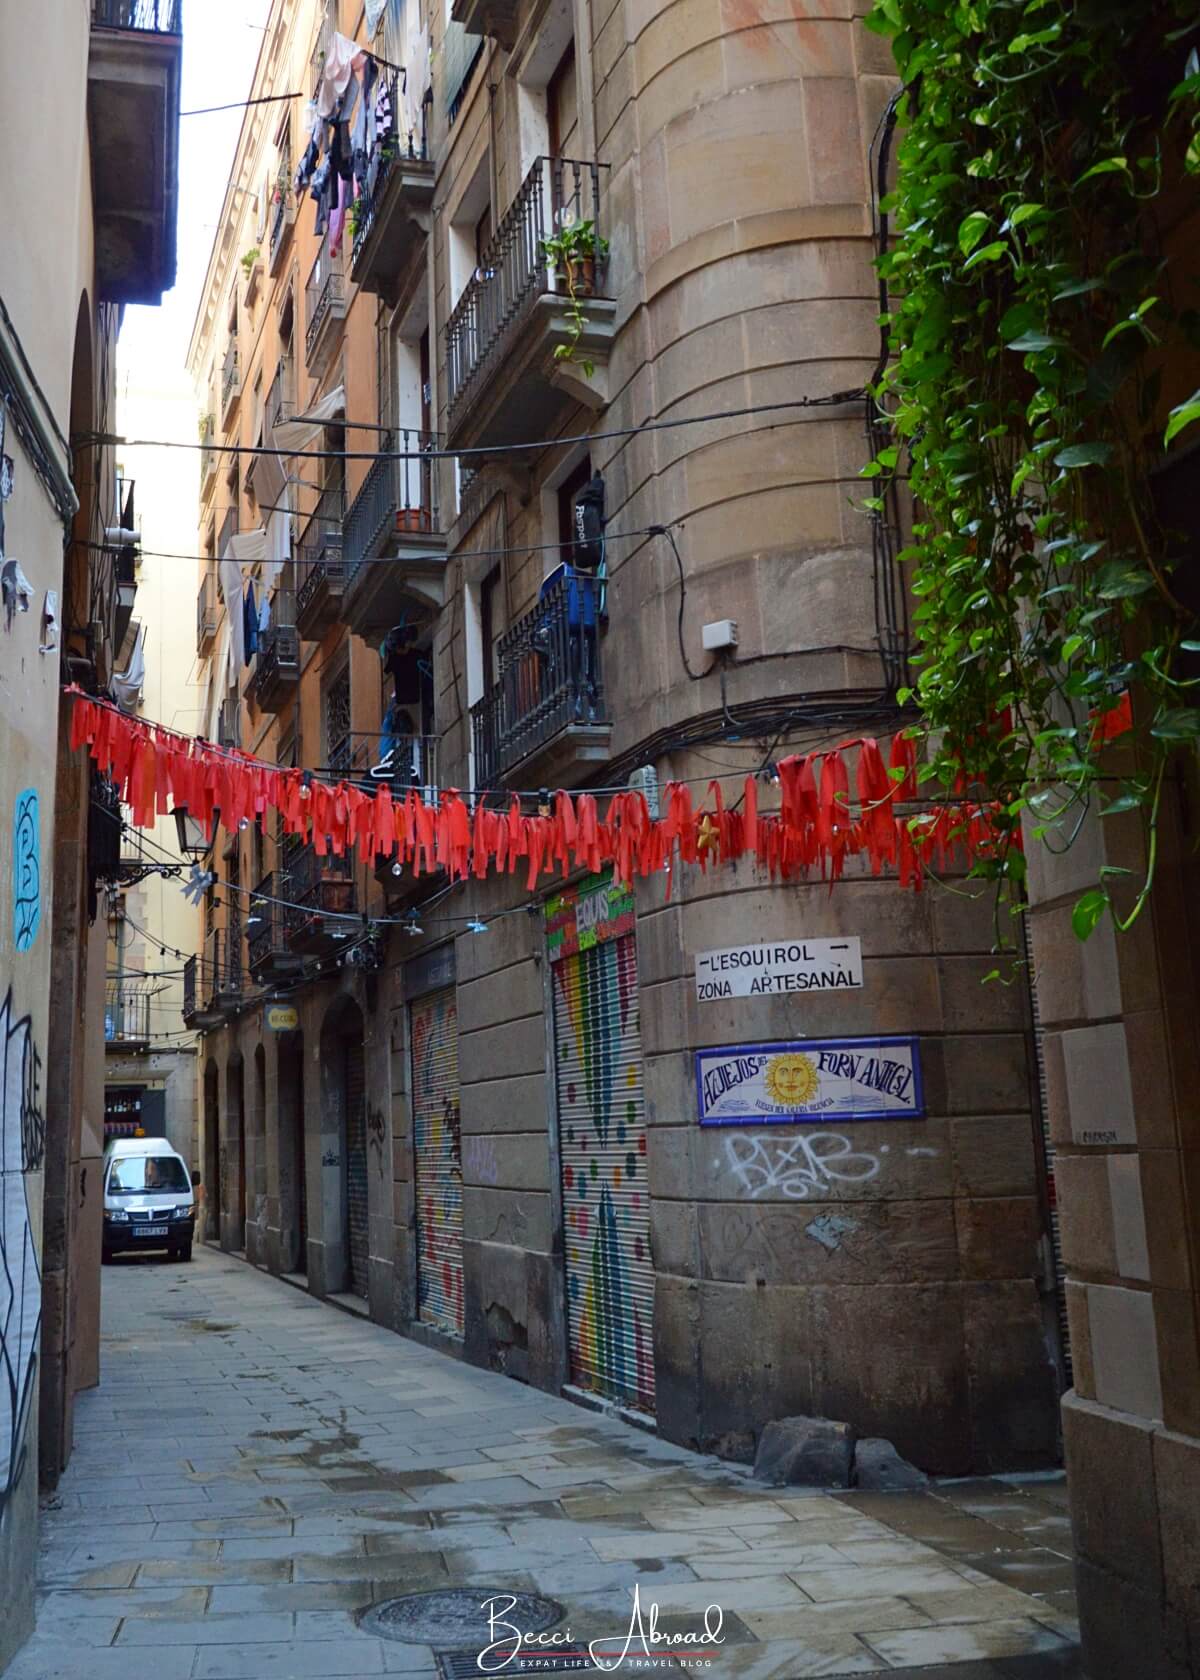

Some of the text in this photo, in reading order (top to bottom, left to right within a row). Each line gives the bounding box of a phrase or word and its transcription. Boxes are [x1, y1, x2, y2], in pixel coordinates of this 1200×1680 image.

[710, 945, 815, 972] L'ESQUIROL
[698, 970, 862, 1000] ZONA ARTESANAL
[816, 1052, 864, 1080] FORN
